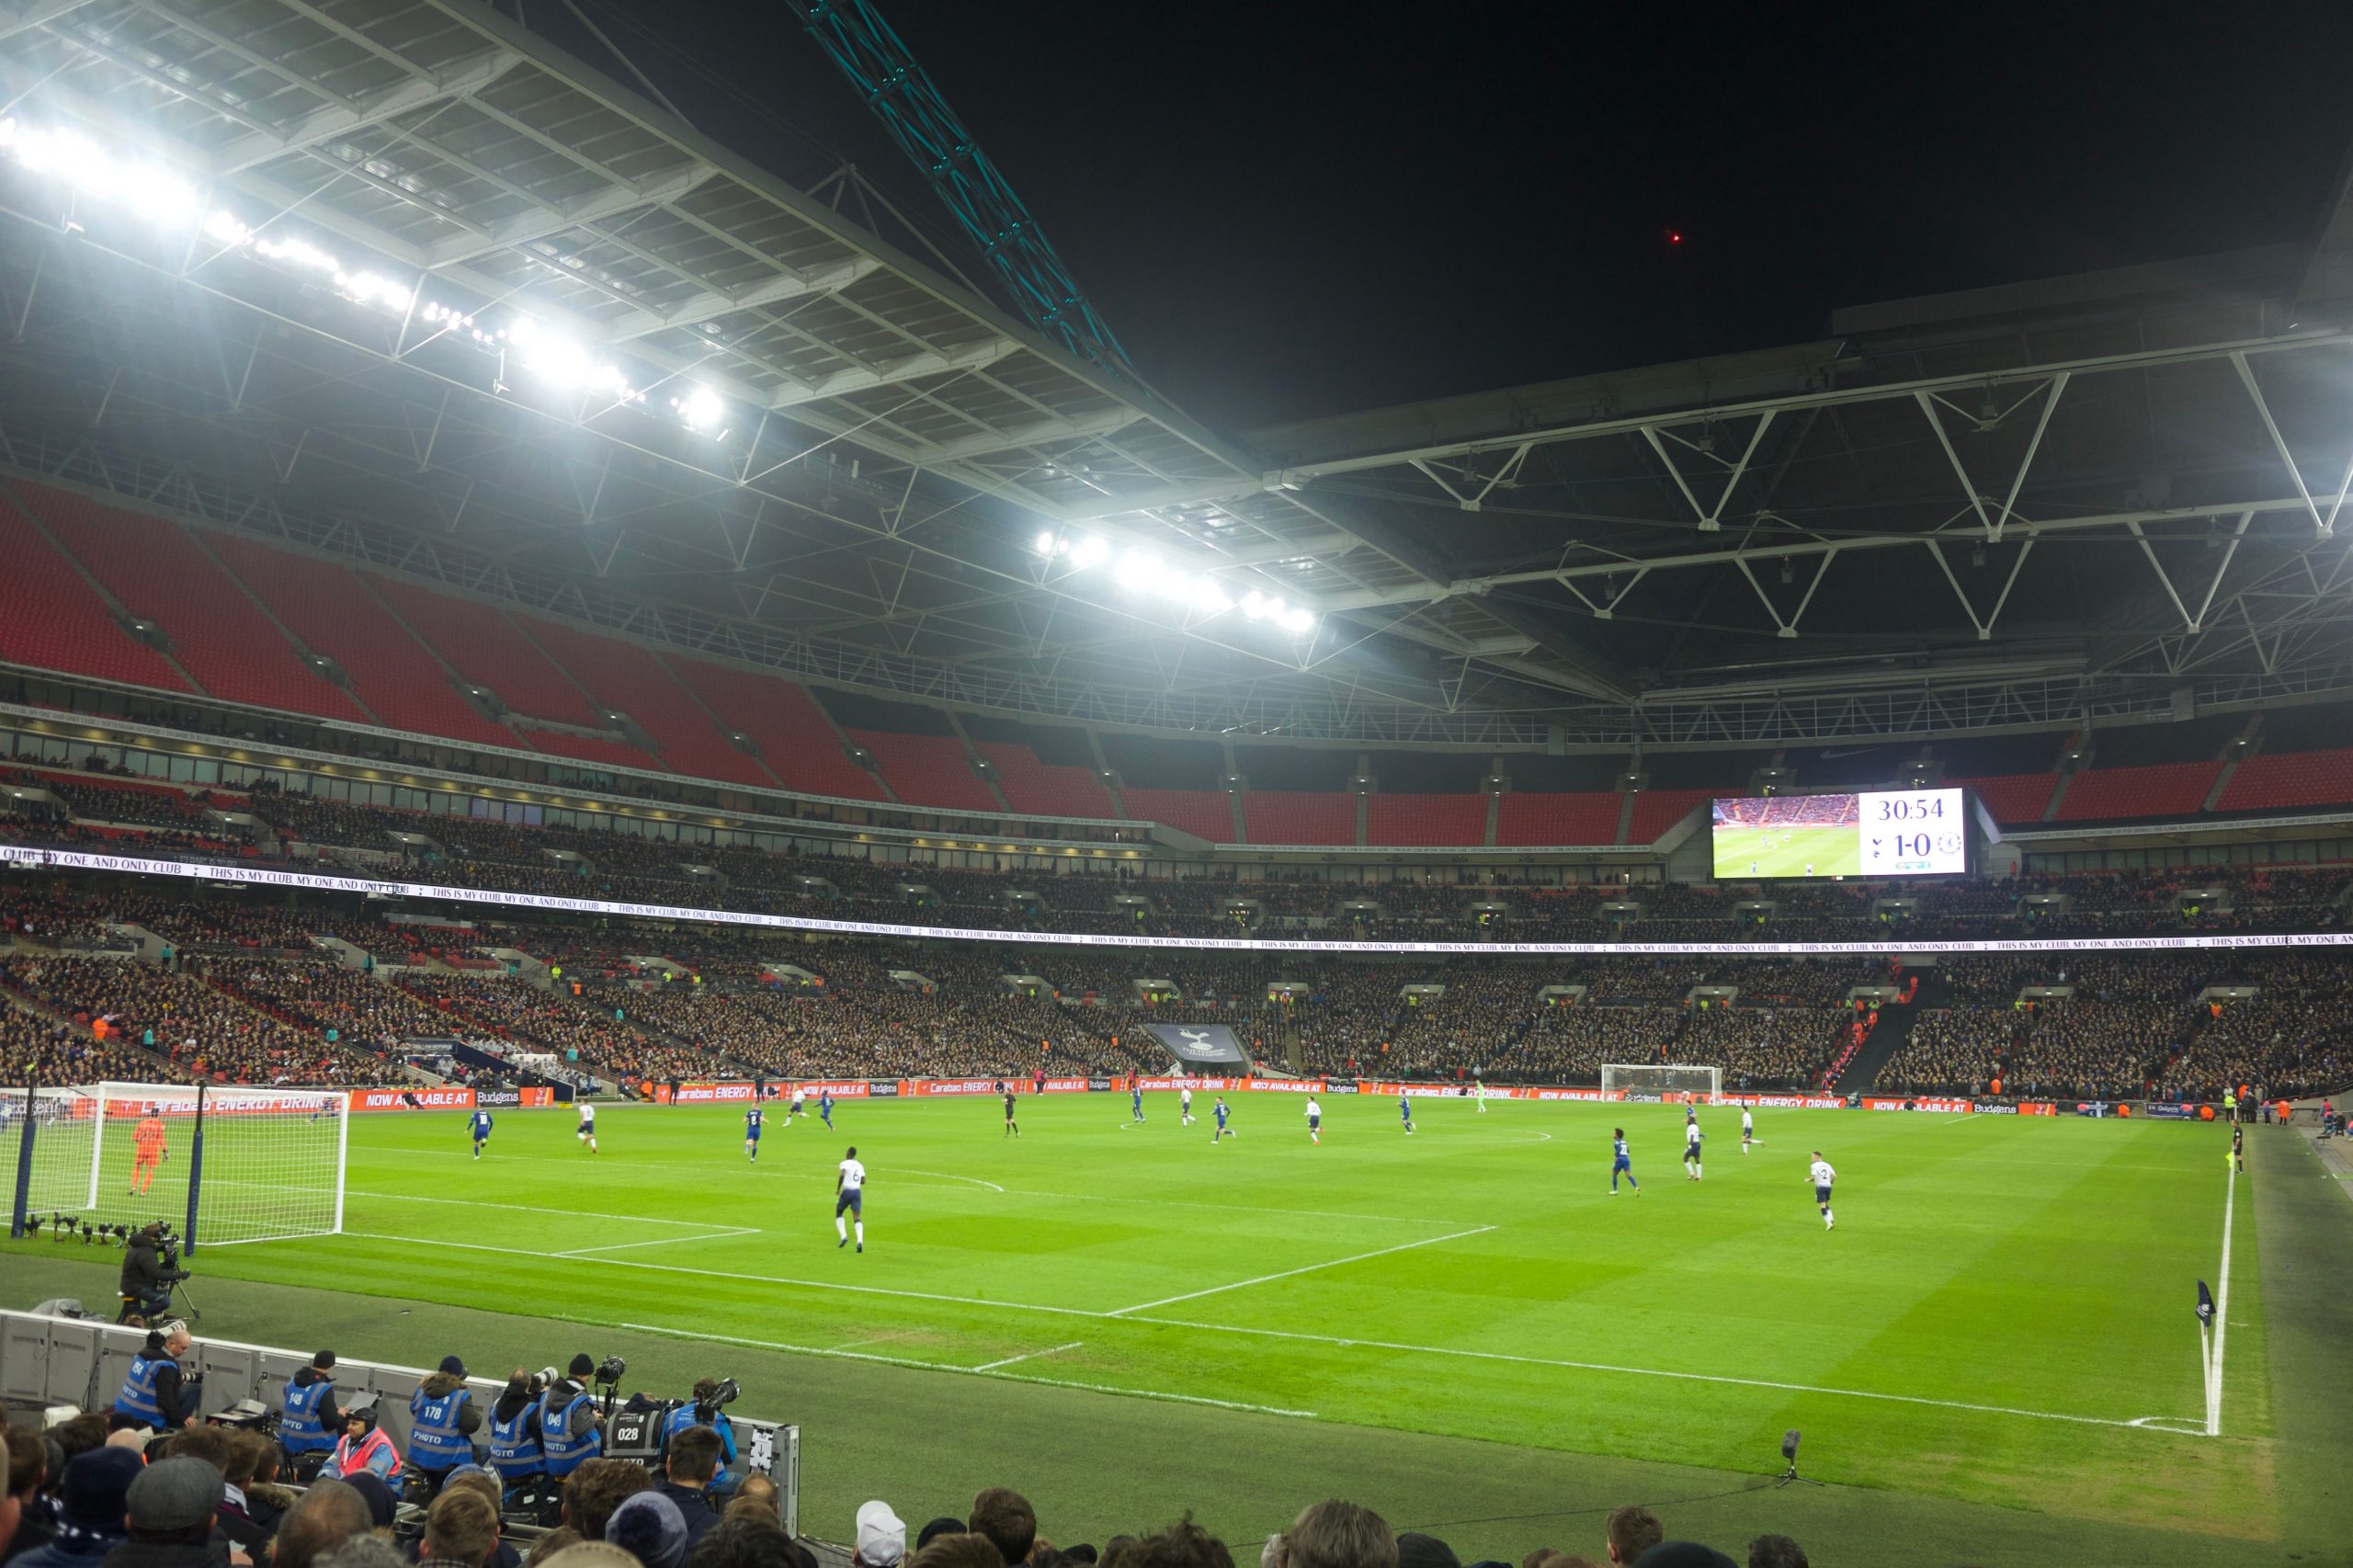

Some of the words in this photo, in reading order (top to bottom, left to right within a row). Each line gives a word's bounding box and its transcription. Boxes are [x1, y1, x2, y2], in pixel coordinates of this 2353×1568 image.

[1879, 798, 1945, 821] 30:54
[1894, 833, 1931, 857] 1-0
[63, 852, 88, 867] ONE
[92, 855, 118, 869] AND
[121, 858, 150, 872] ONLY
[153, 860, 182, 875] CLUB
[209, 866, 233, 880] THIS
[235, 869, 245, 881] IS
[246, 869, 264, 882] MY
[296, 874, 313, 886] MY
[314, 876, 335, 889] ONE
[337, 878, 358, 891] AND
[433, 886, 451, 898] THIS
[453, 888, 461, 899] IS
[464, 889, 478, 901] MY
[505, 892, 517, 904] MY
[518, 894, 536, 905] ONE
[538, 896, 556, 907] AND
[557, 898, 577, 909] ONLY
[579, 900, 599, 911] CLUB
[619, 903, 635, 914] THIS
[636, 904, 643, 915] IS
[645, 905, 657, 915] MY
[680, 908, 691, 918] MY
[692, 909, 707, 919] ONE
[710, 911, 724, 921] AND
[725, 912, 743, 923] ONLY
[745, 914, 762, 924] CLUB
[1801, 943, 1819, 951] THIS
[1821, 943, 1829, 951] IS
[1831, 943, 1844, 951] MY
[1871, 942, 1884, 951] MY
[1887, 942, 1904, 951] ONE
[1907, 942, 1926, 951] AND
[1927, 942, 1949, 950] ONLY
[1951, 941, 1974, 950] CLUB
[1997, 941, 2017, 949] THIS
[2018, 940, 2028, 949] IS
[2029, 940, 2043, 949] MY
[2073, 939, 2087, 949] MY
[2089, 939, 2109, 949] ONE
[2111, 938, 2132, 948] AND
[2134, 938, 2158, 948] ONLY
[2160, 937, 2186, 947] CLUB
[2211, 937, 2234, 946] THIS
[2235, 937, 2245, 946] IS
[2246, 936, 2263, 946] MY
[2297, 935, 2313, 944] MY
[2315, 935, 2337, 944] ONE
[2340, 934, 2353, 943] AN
[870, 1083, 897, 1095] Budgens
[930, 1083, 961, 1093] Carabao
[963, 1081, 992, 1092] ENERGY
[1047, 1081, 1074, 1090] AVAILABLE
[1074, 1080, 1085, 1089] AT
[1140, 1079, 1170, 1089] Carabao
[1172, 1079, 1201, 1089] ENERGY
[1202, 1079, 1224, 1089] DRINK
[1250, 1081, 1269, 1090] NOW
[1269, 1082, 1311, 1092] AVAILABLE
[1310, 1084, 1321, 1092] AT
[1326, 1084, 1358, 1094] Budgens
[715, 1086, 751, 1099] ENERGY
[803, 1086, 820, 1096] NOW
[820, 1085, 855, 1095] AVAILABLE
[855, 1085, 865, 1094] AT
[1399, 1087, 1438, 1096] Carabao
[1441, 1087, 1481, 1098] ENEGY
[1483, 1089, 1512, 1099] DRINK
[1539, 1091, 1562, 1100] NOW
[1606, 1094, 1619, 1102] AT
[366, 1094, 398, 1107] NOW
[400, 1093, 454, 1106] AILABLE
[454, 1092, 469, 1104] AT
[477, 1091, 519, 1105] Budgens
[1758, 1096, 1803, 1107] ENERGY
[1805, 1097, 1842, 1108] DRINK
[1873, 1101, 1896, 1111] NOW
[1897, 1102, 1950, 1112] AILABLE
[1951, 1105, 1966, 1113] AT
[1973, 1103, 2017, 1114] Budgens
[853, 1169, 859, 1182] 6
[1821, 1168, 1827, 1179] 2
[425, 1406, 442, 1420] 178
[414, 1430, 441, 1445] PHOTO
[618, 1427, 639, 1441] 028
